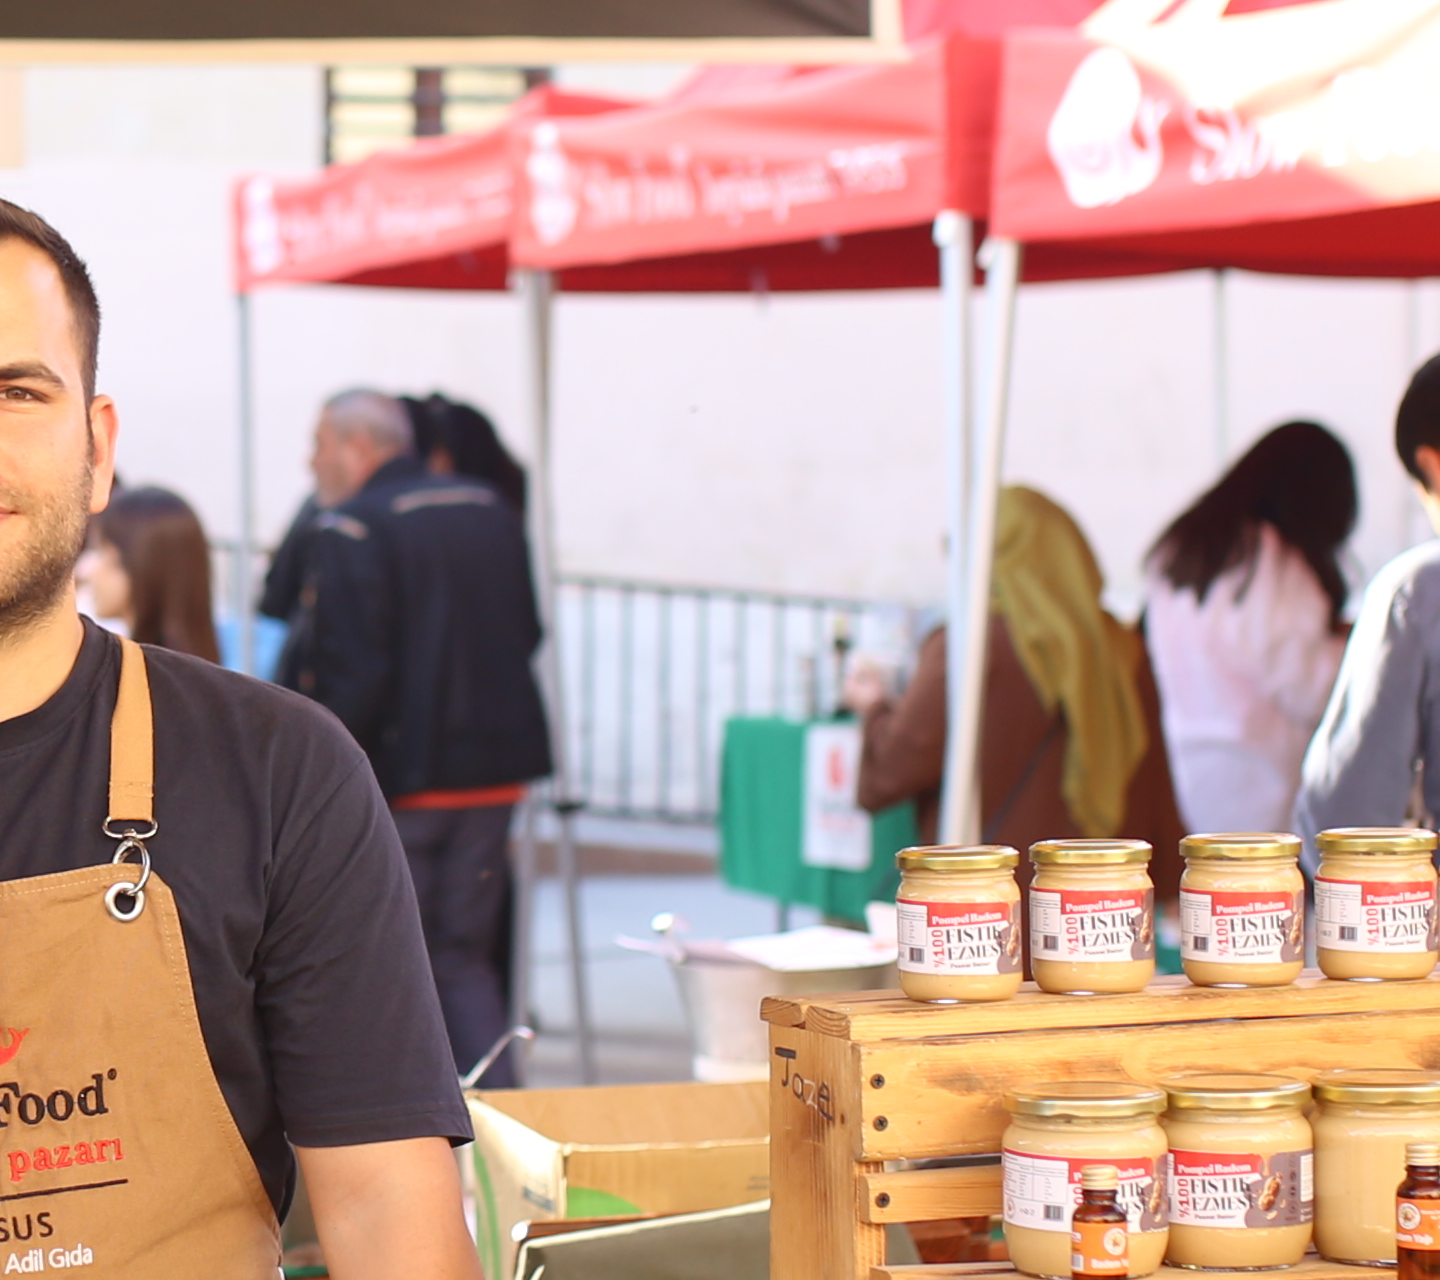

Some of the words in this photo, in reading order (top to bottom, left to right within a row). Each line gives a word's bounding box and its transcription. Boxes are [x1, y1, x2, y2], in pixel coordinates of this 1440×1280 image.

[8, 1138, 124, 1182] pazarı
[5, 1249, 44, 1275] Adil
[48, 1243, 93, 1269] Gıda
